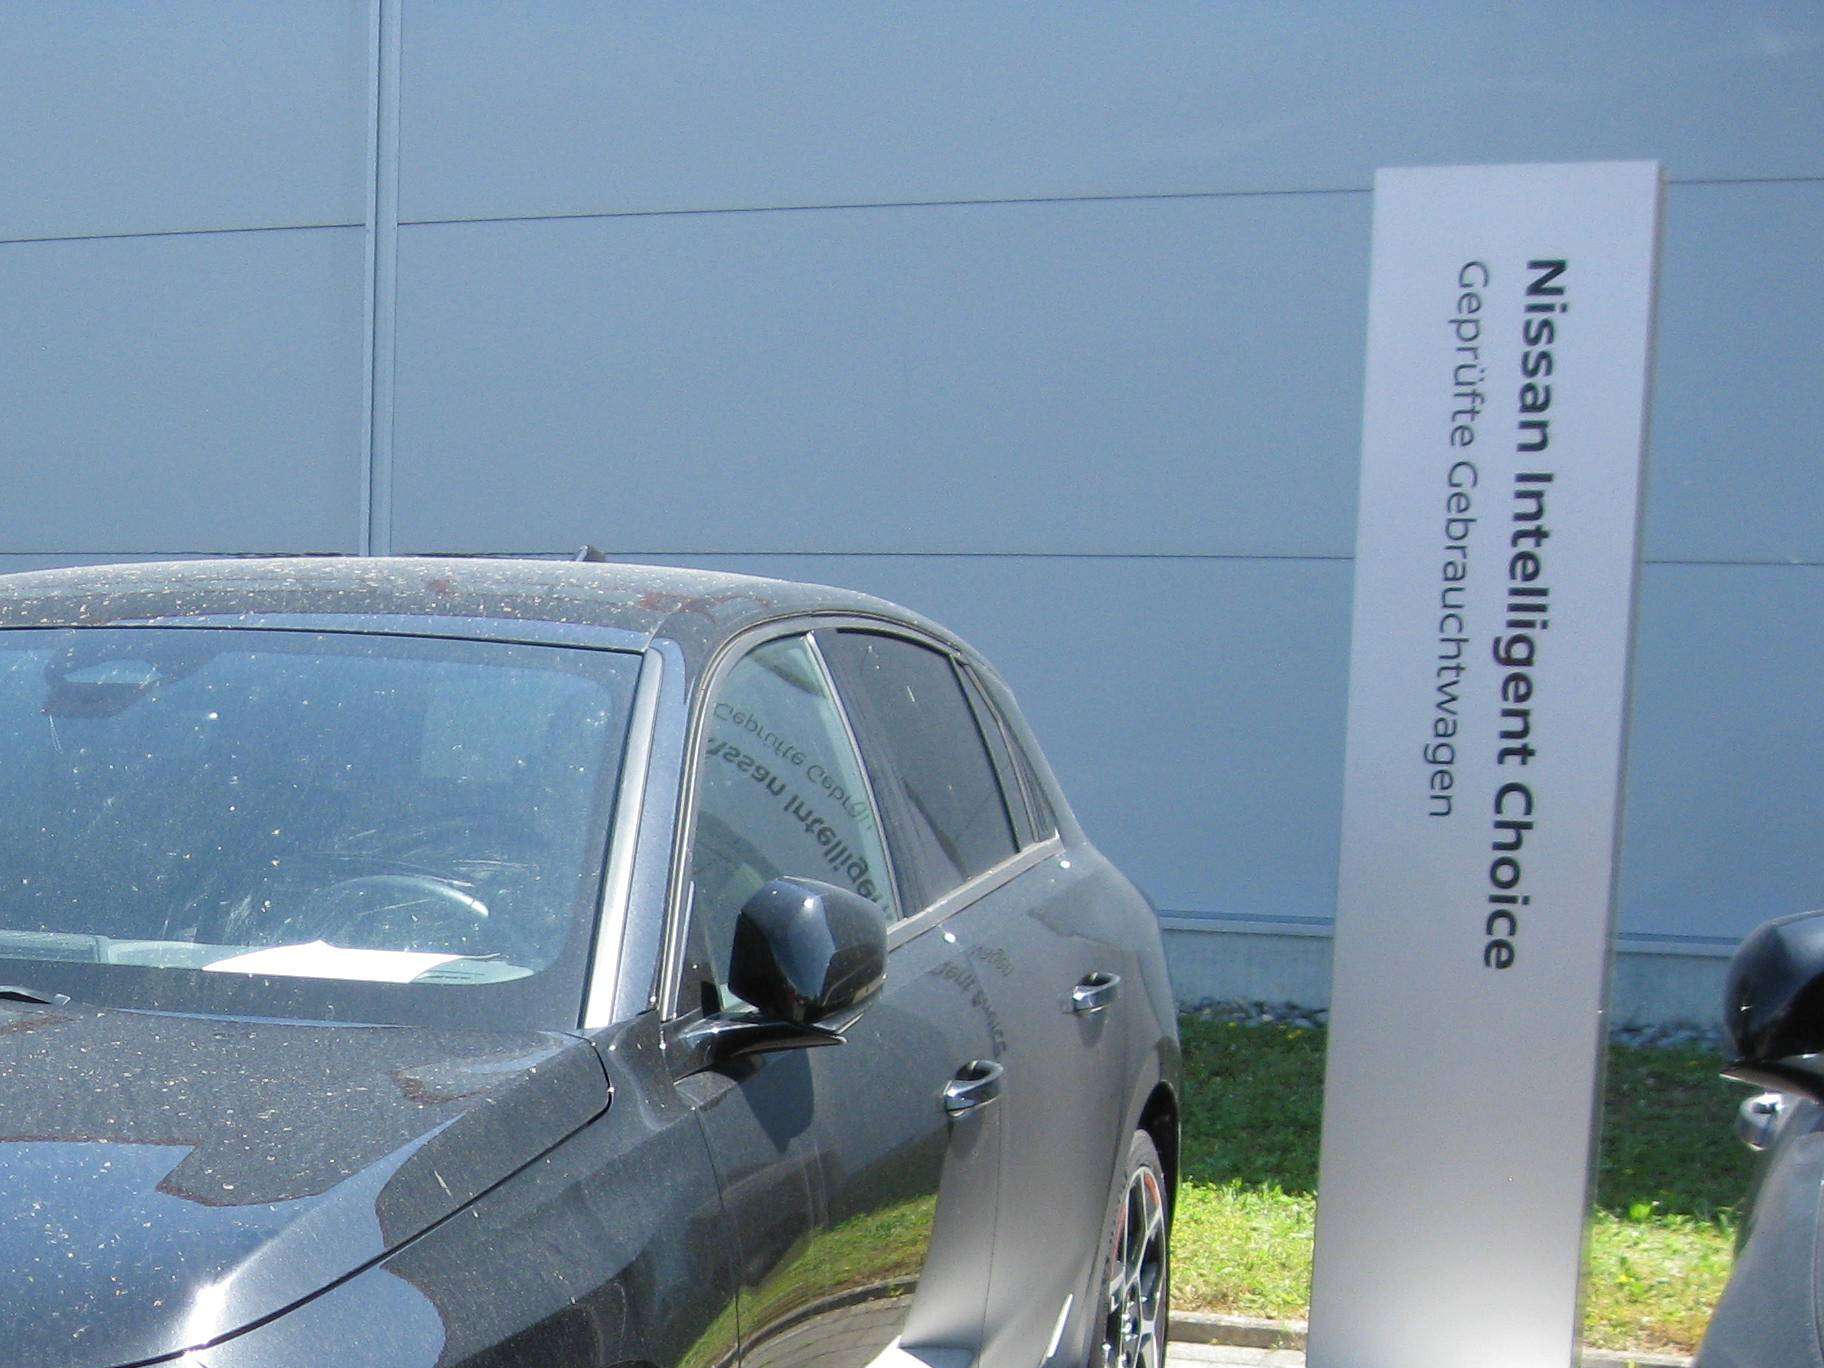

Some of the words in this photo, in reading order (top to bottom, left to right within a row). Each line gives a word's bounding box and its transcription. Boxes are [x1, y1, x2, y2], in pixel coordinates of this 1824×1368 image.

[1447, 260, 1490, 448] Geprüfte
[1517, 258, 1569, 453] Nissan
[1423, 460, 1479, 818] Gebrauchtwagen
[1493, 472, 1555, 766] Intelligent
[1483, 781, 1535, 970] Choice
